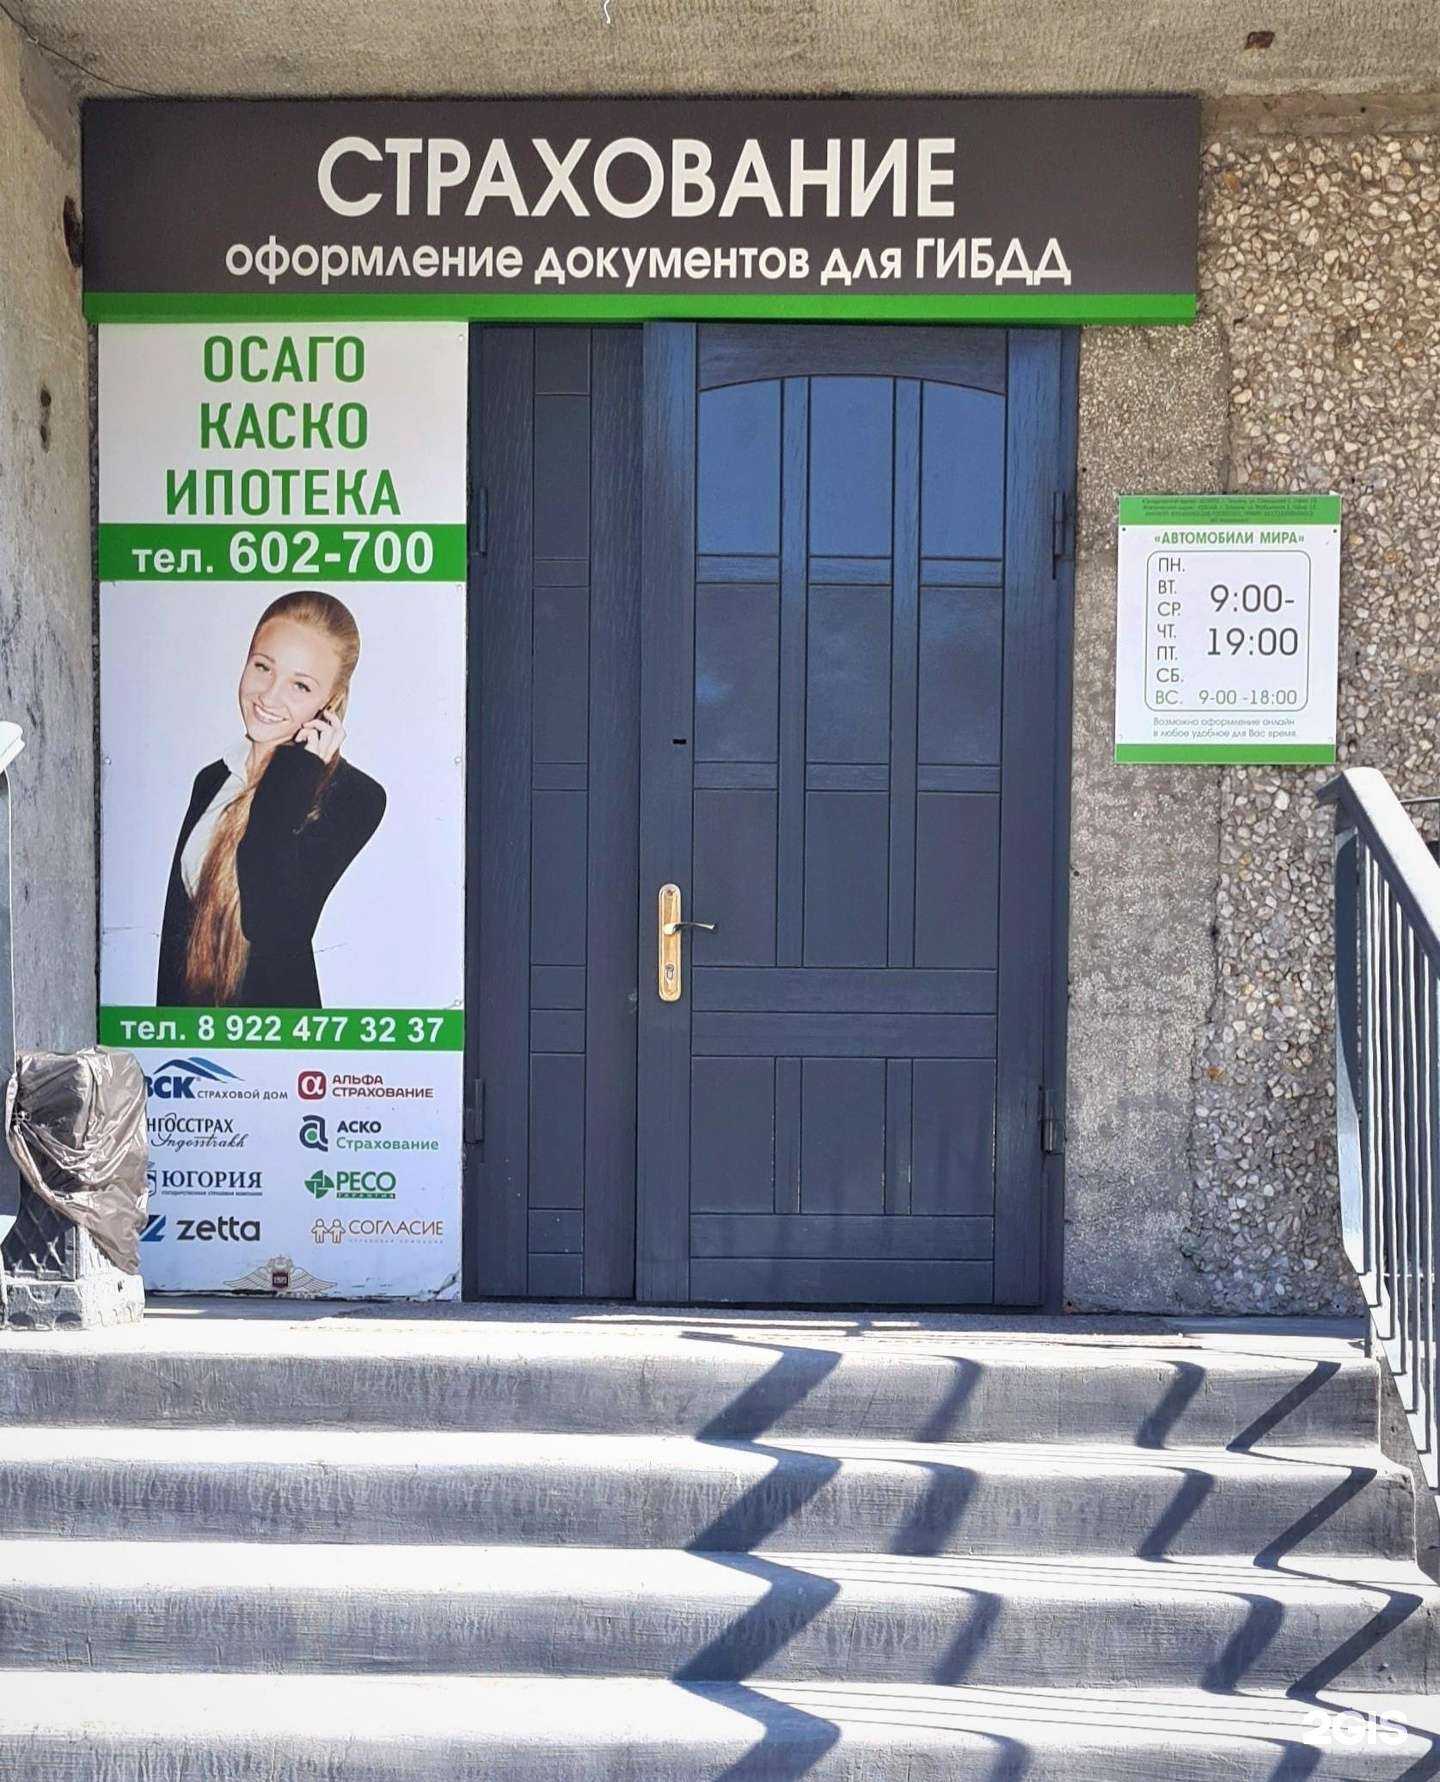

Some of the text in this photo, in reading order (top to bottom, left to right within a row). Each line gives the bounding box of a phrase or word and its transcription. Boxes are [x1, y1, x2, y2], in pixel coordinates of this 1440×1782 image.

[317, 136, 956, 219] СТРАХОВАНИЕ
[225, 235, 1072, 287] оформление документов для ГИБДД
[203, 335, 365, 383] ОСАГО
[200, 401, 368, 449] КАСКО
[166, 468, 401, 516] ИПОТЕКА
[1154, 531, 1254, 544] «АВТОМОБИЛИ
[132, 530, 434, 574] тел. 602-700
[1158, 558, 1185, 572] ПН.
[1158, 580, 1177, 594] ВТ.
[1210, 584, 1295, 612] 9:00-
[1157, 602, 1181, 616] СР.
[1157, 624, 1176, 638] ЧТ.
[1207, 628, 1298, 656] 19:00
[1157, 646, 1178, 660] ПТ.
[1156, 668, 1184, 682] СБ.
[1155, 690, 1183, 704] ВС.
[1199, 690, 1237, 705] 9-00
[1153, 717, 1199, 726] Возможно
[120, 1015, 444, 1043] тел. 8 922 477 32 37
[332, 1074, 383, 1085] АЛЬФА
[197, 1089, 288, 1100] СТРАХОВОЙ ДОМ
[332, 1087, 434, 1098] СТРАХОВАНИЕ
[147, 1113, 234, 1133] НГОССТРАХ
[337, 1121, 382, 1133] АСКО
[151, 1131, 248, 1152] Ingosstrakh
[336, 1137, 439, 1151] Страхование
[162, 1170, 263, 1188] ЮГОРИЯ
[336, 1171, 396, 1191] РЕСО
[176, 1216, 261, 1241] zetta
[349, 1220, 444, 1235] СОГЛАСИЕ
